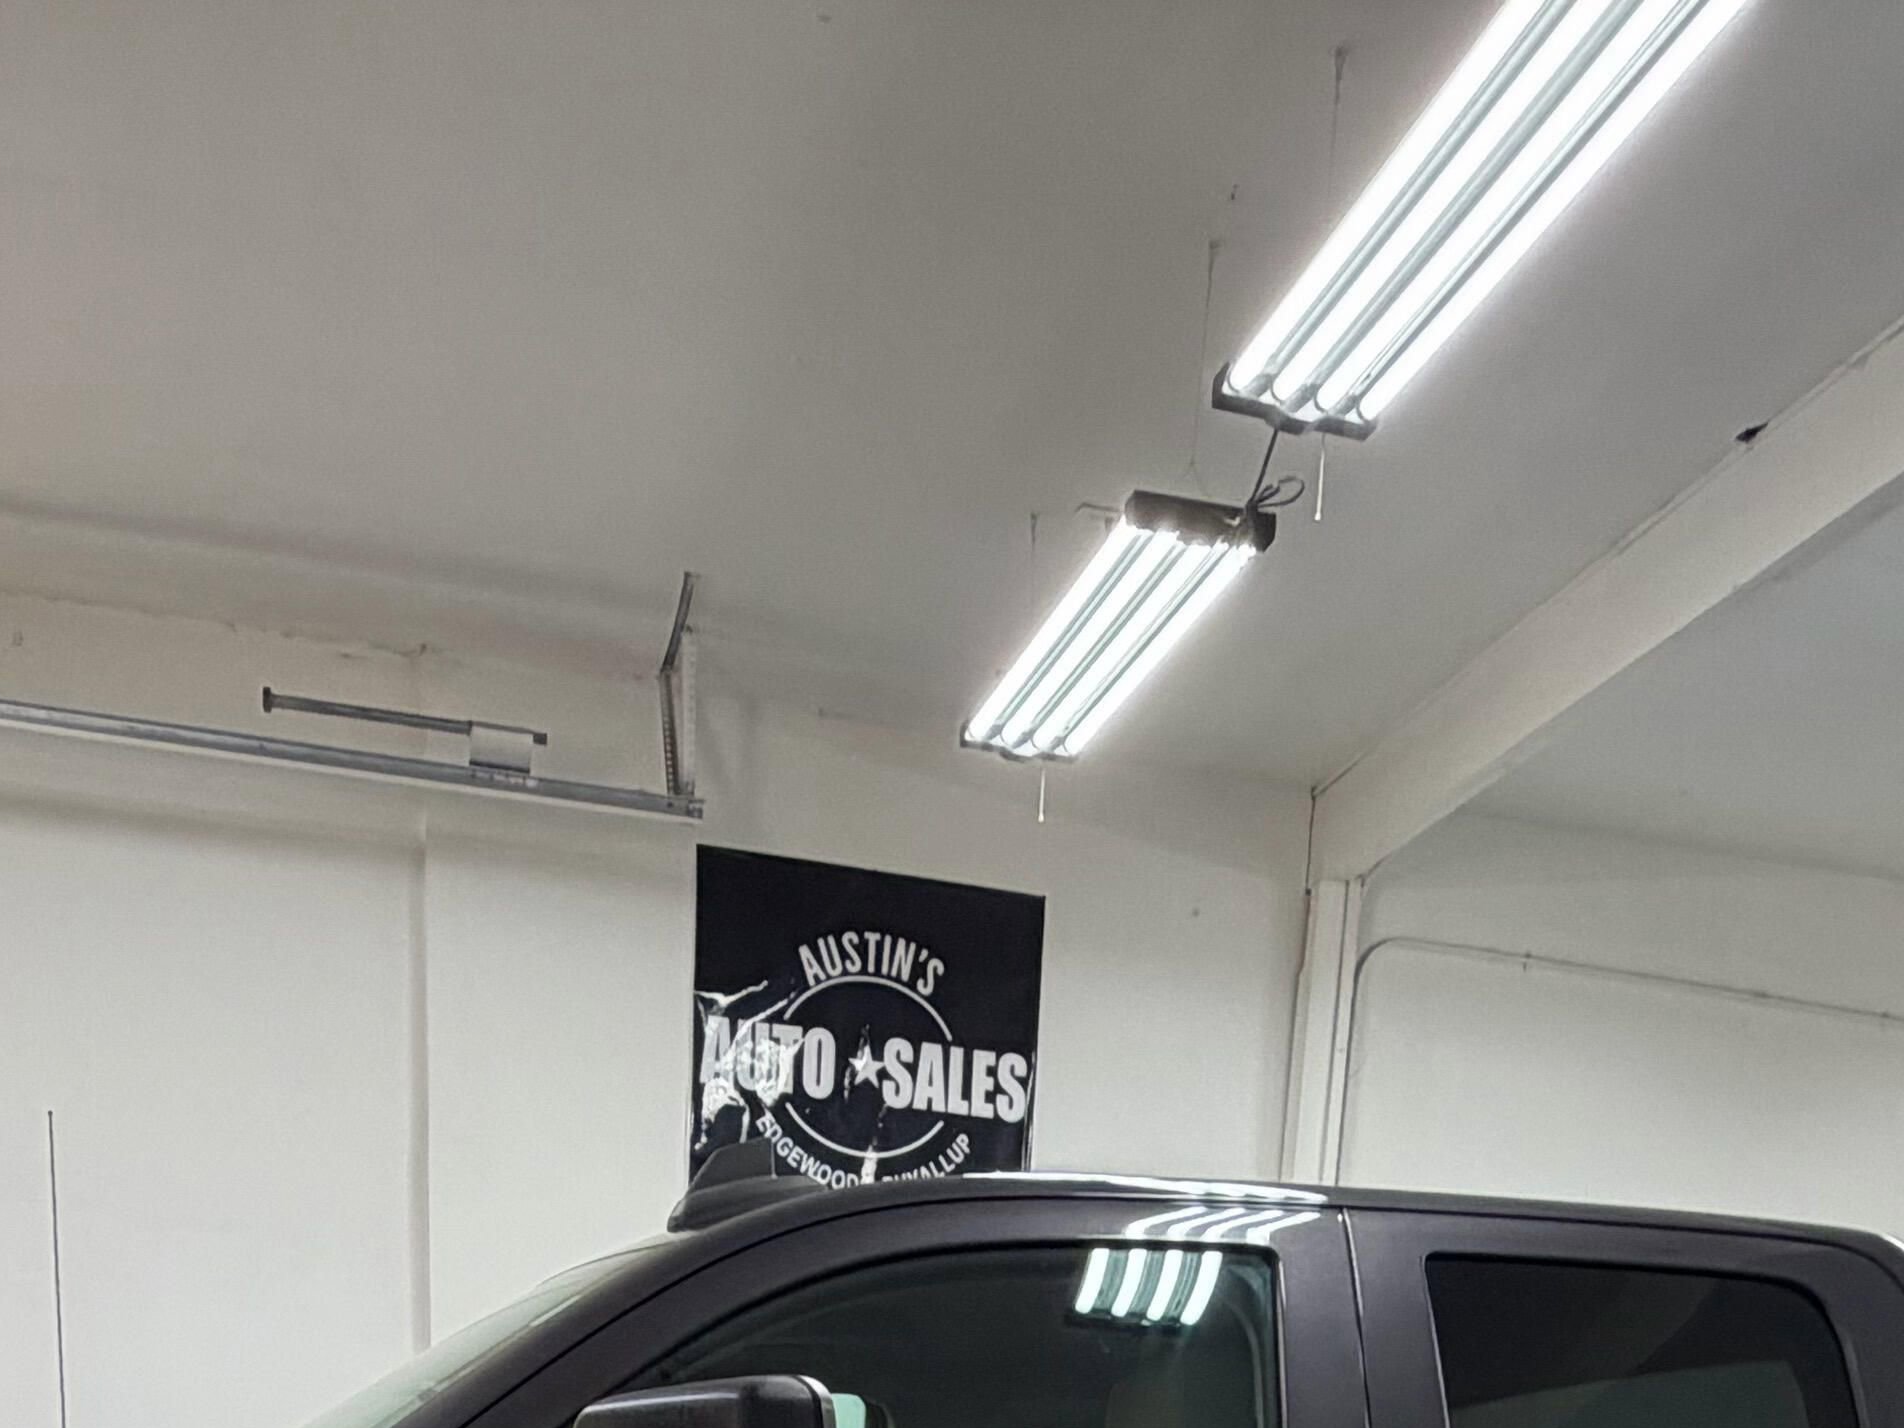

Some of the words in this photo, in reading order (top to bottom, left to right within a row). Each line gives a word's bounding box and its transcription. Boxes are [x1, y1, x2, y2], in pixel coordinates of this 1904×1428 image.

[798, 930, 946, 997] AUSTIN'S
[699, 1014, 837, 1100] AUTO
[882, 1037, 1028, 1124] SALES
